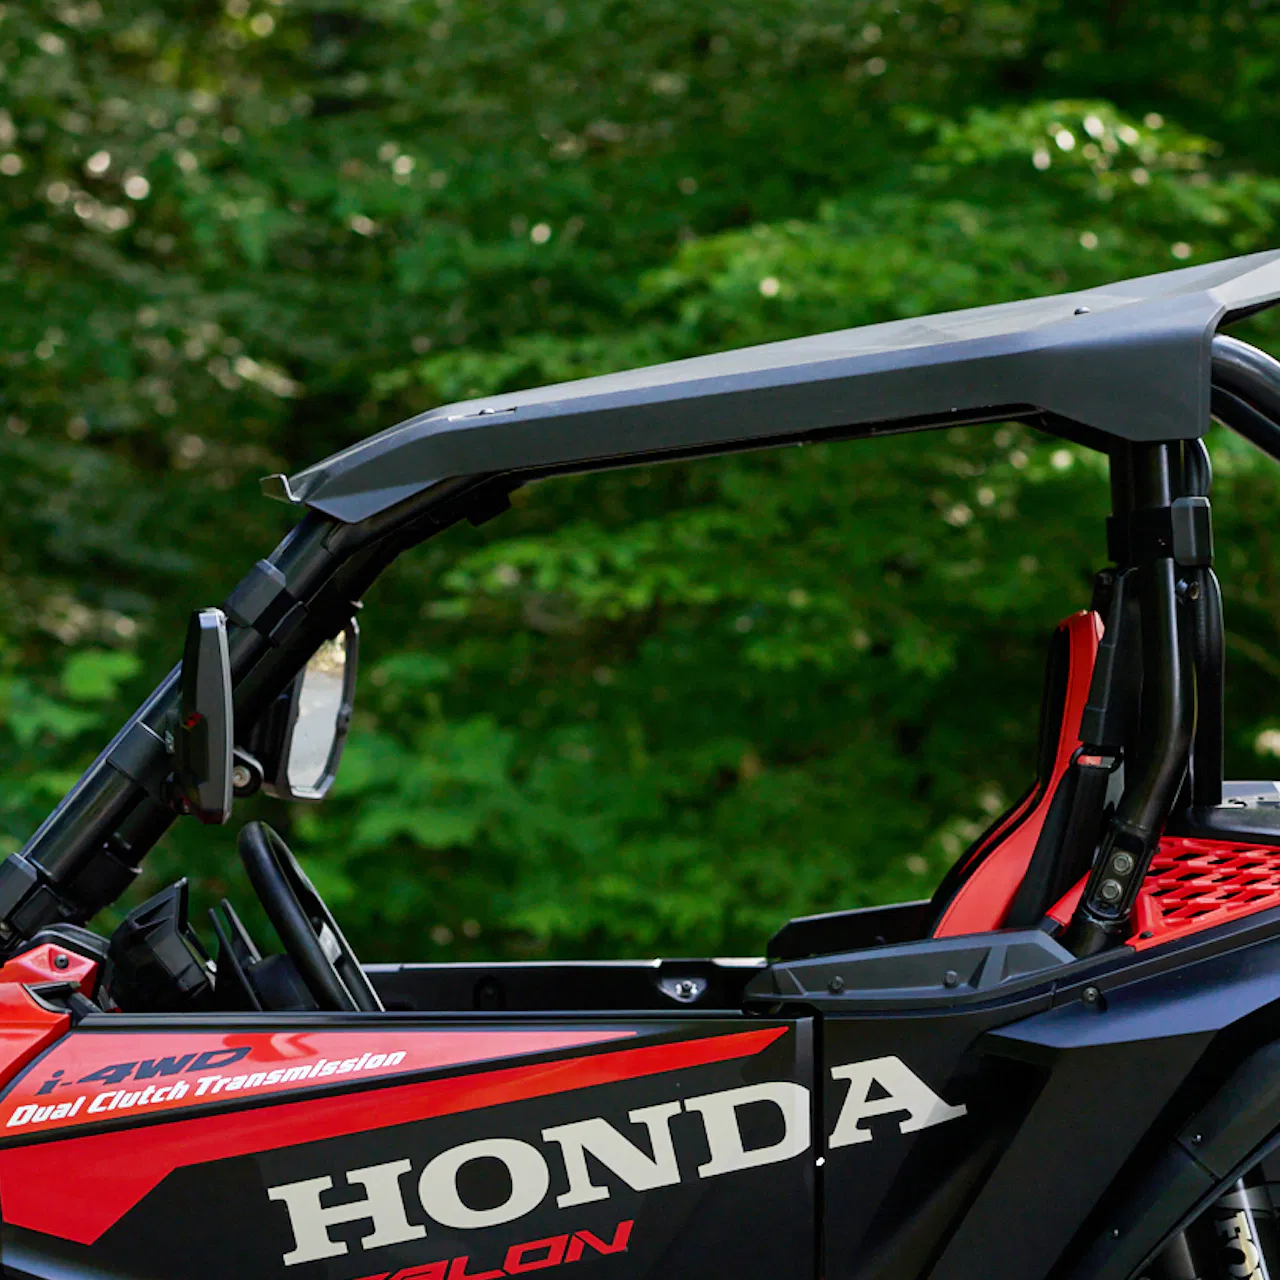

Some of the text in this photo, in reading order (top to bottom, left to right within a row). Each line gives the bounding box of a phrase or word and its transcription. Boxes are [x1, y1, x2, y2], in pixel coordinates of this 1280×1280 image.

[5, 1050, 407, 1128] Dual Clutch Transmission
[34, 1046, 252, 1097] i-4WD
[267, 1055, 968, 1267] HONDA
